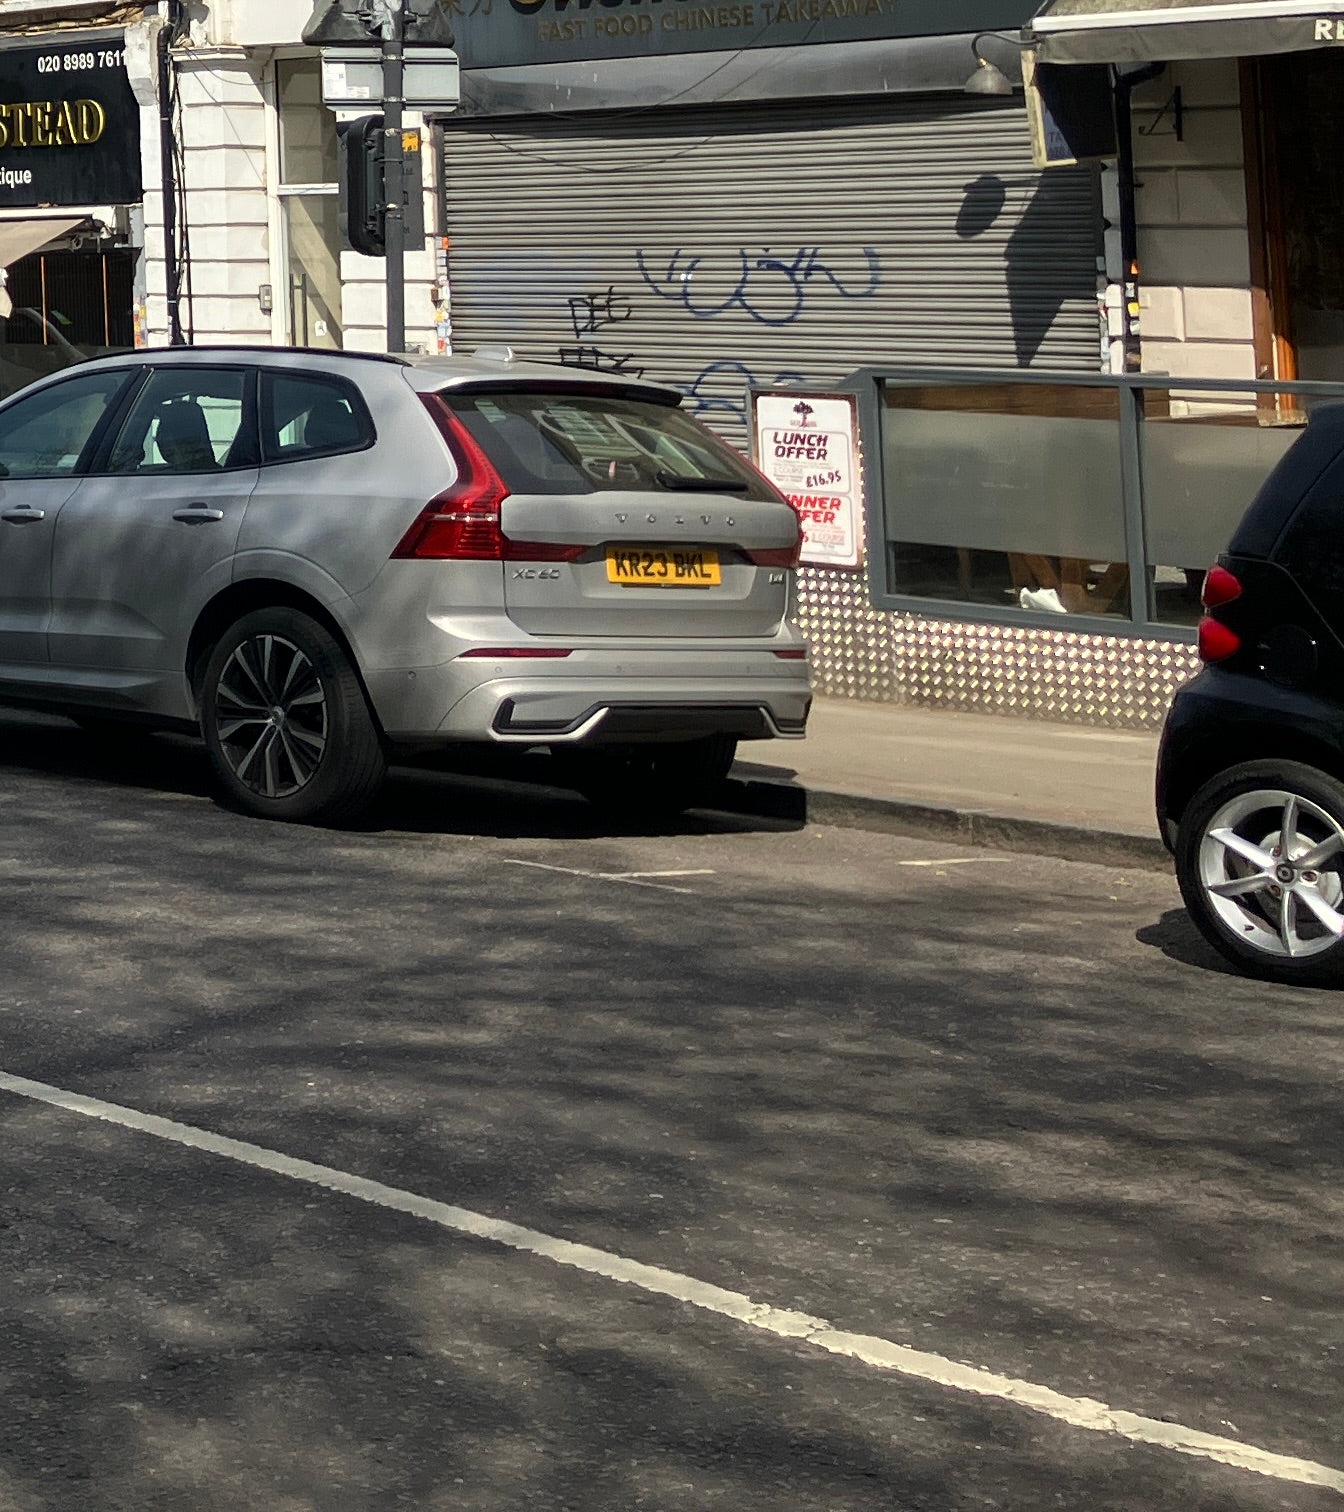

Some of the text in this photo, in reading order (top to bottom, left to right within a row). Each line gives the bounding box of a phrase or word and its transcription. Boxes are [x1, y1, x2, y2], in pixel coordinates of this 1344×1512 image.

[538, 19, 586, 42] FAST
[593, 13, 653, 38] FOOD
[662, 4, 754, 33] CHINESE
[37, 50, 127, 73] 020 8989 7611
[773, 431, 828, 447] LUNCH
[775, 446, 828, 461] OFFER
[806, 470, 842, 488] £16.95
[614, 551, 712, 578] KR23 BKL
